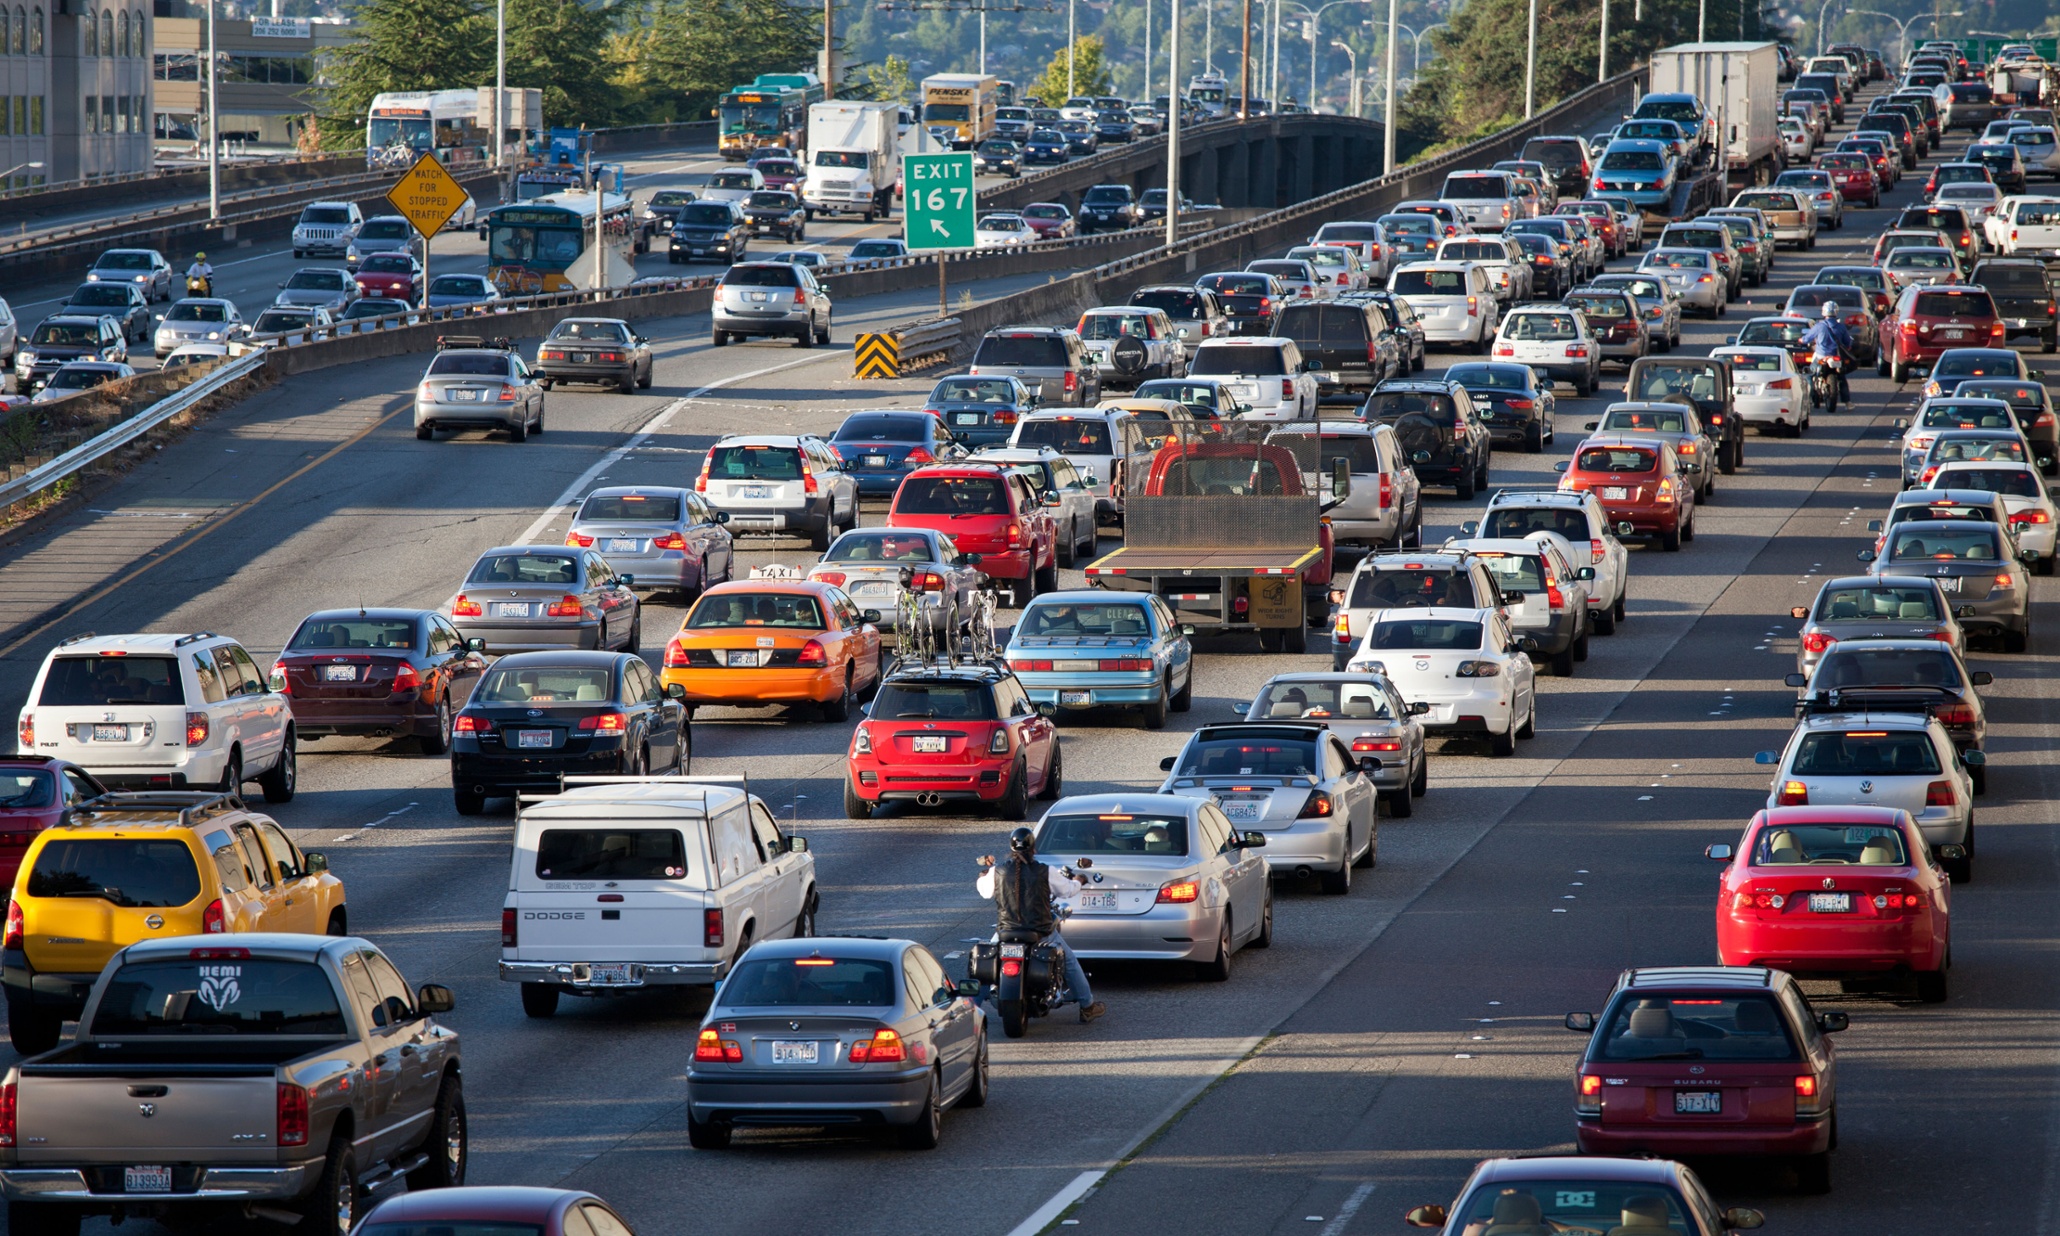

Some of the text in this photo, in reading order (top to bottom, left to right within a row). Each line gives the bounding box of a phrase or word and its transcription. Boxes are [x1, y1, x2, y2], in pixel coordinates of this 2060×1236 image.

[254, 17, 296, 27] FOR LEASE
[928, 88, 972, 97] PENSKE
[415, 170, 442, 179] WATCH
[913, 163, 963, 180] EXIT
[419, 183, 437, 192] FOR
[408, 196, 448, 206] STOPPED
[911, 187, 968, 211] 167
[410, 210, 446, 220] TRAFFIC
[759, 568, 793, 578] TAXI
[545, 882, 597, 890] GEM TOP
[524, 912, 585, 920] DODGE
[199, 966, 242, 977] HEMI
[126, 1174, 171, 1188] B13993A
